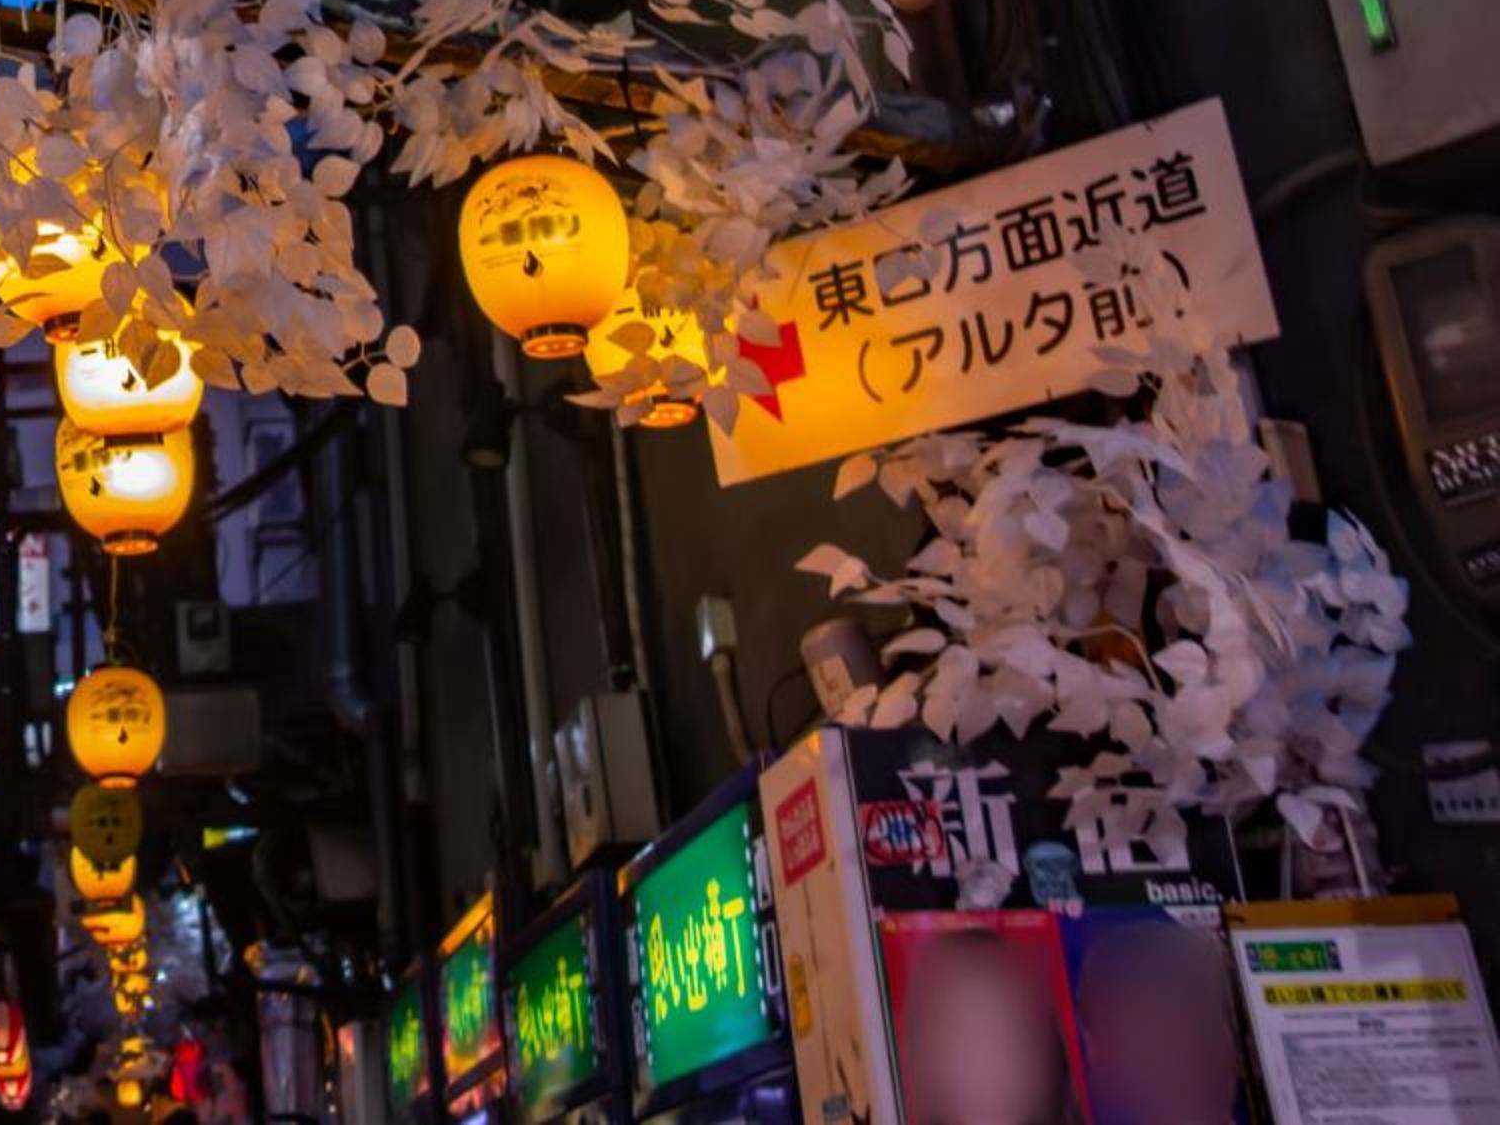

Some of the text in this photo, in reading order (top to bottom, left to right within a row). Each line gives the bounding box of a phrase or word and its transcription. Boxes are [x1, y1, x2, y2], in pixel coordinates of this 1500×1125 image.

[808, 150, 1207, 332] 東口方面近道
[649, 877, 745, 1027] 思い出横丁
